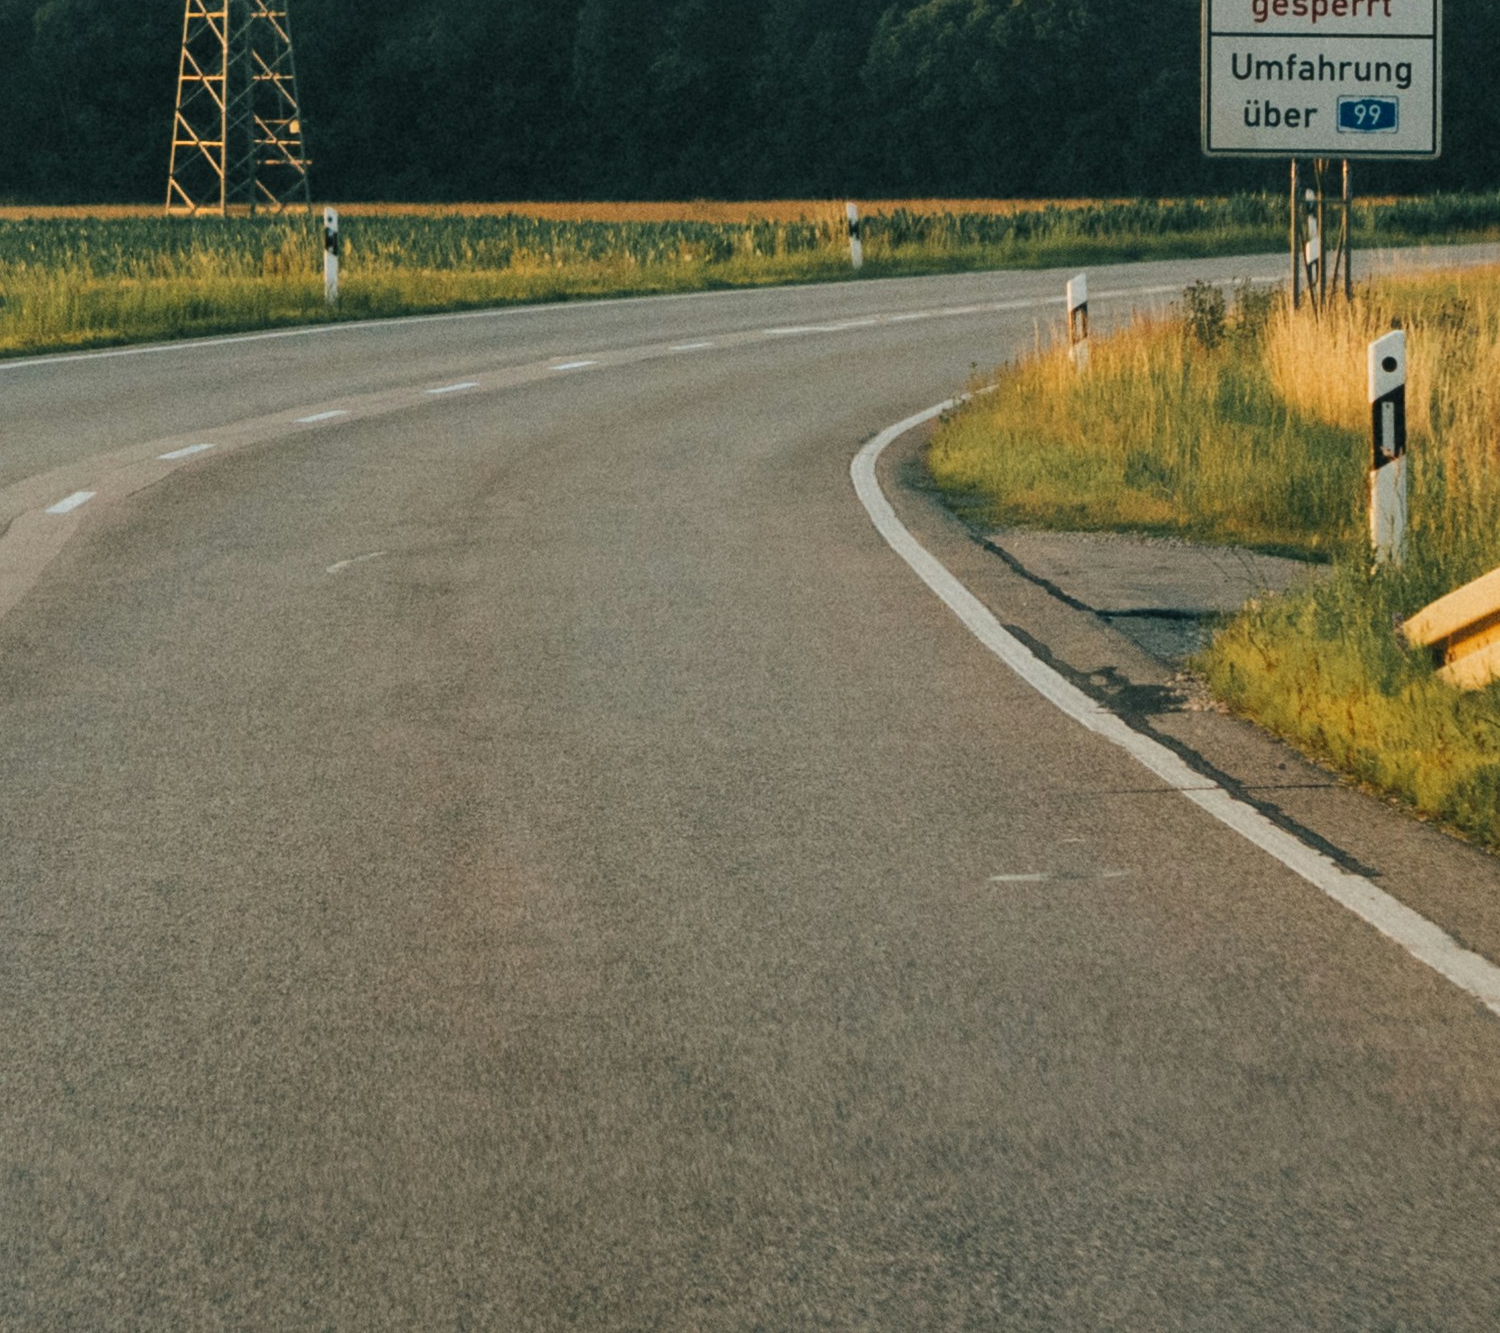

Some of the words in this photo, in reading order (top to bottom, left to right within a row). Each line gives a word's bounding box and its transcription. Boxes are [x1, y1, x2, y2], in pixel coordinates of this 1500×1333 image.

[1231, 53, 1413, 89] Umfahrung
[1243, 100, 1318, 127] über
[1354, 105, 1382, 126] 99
